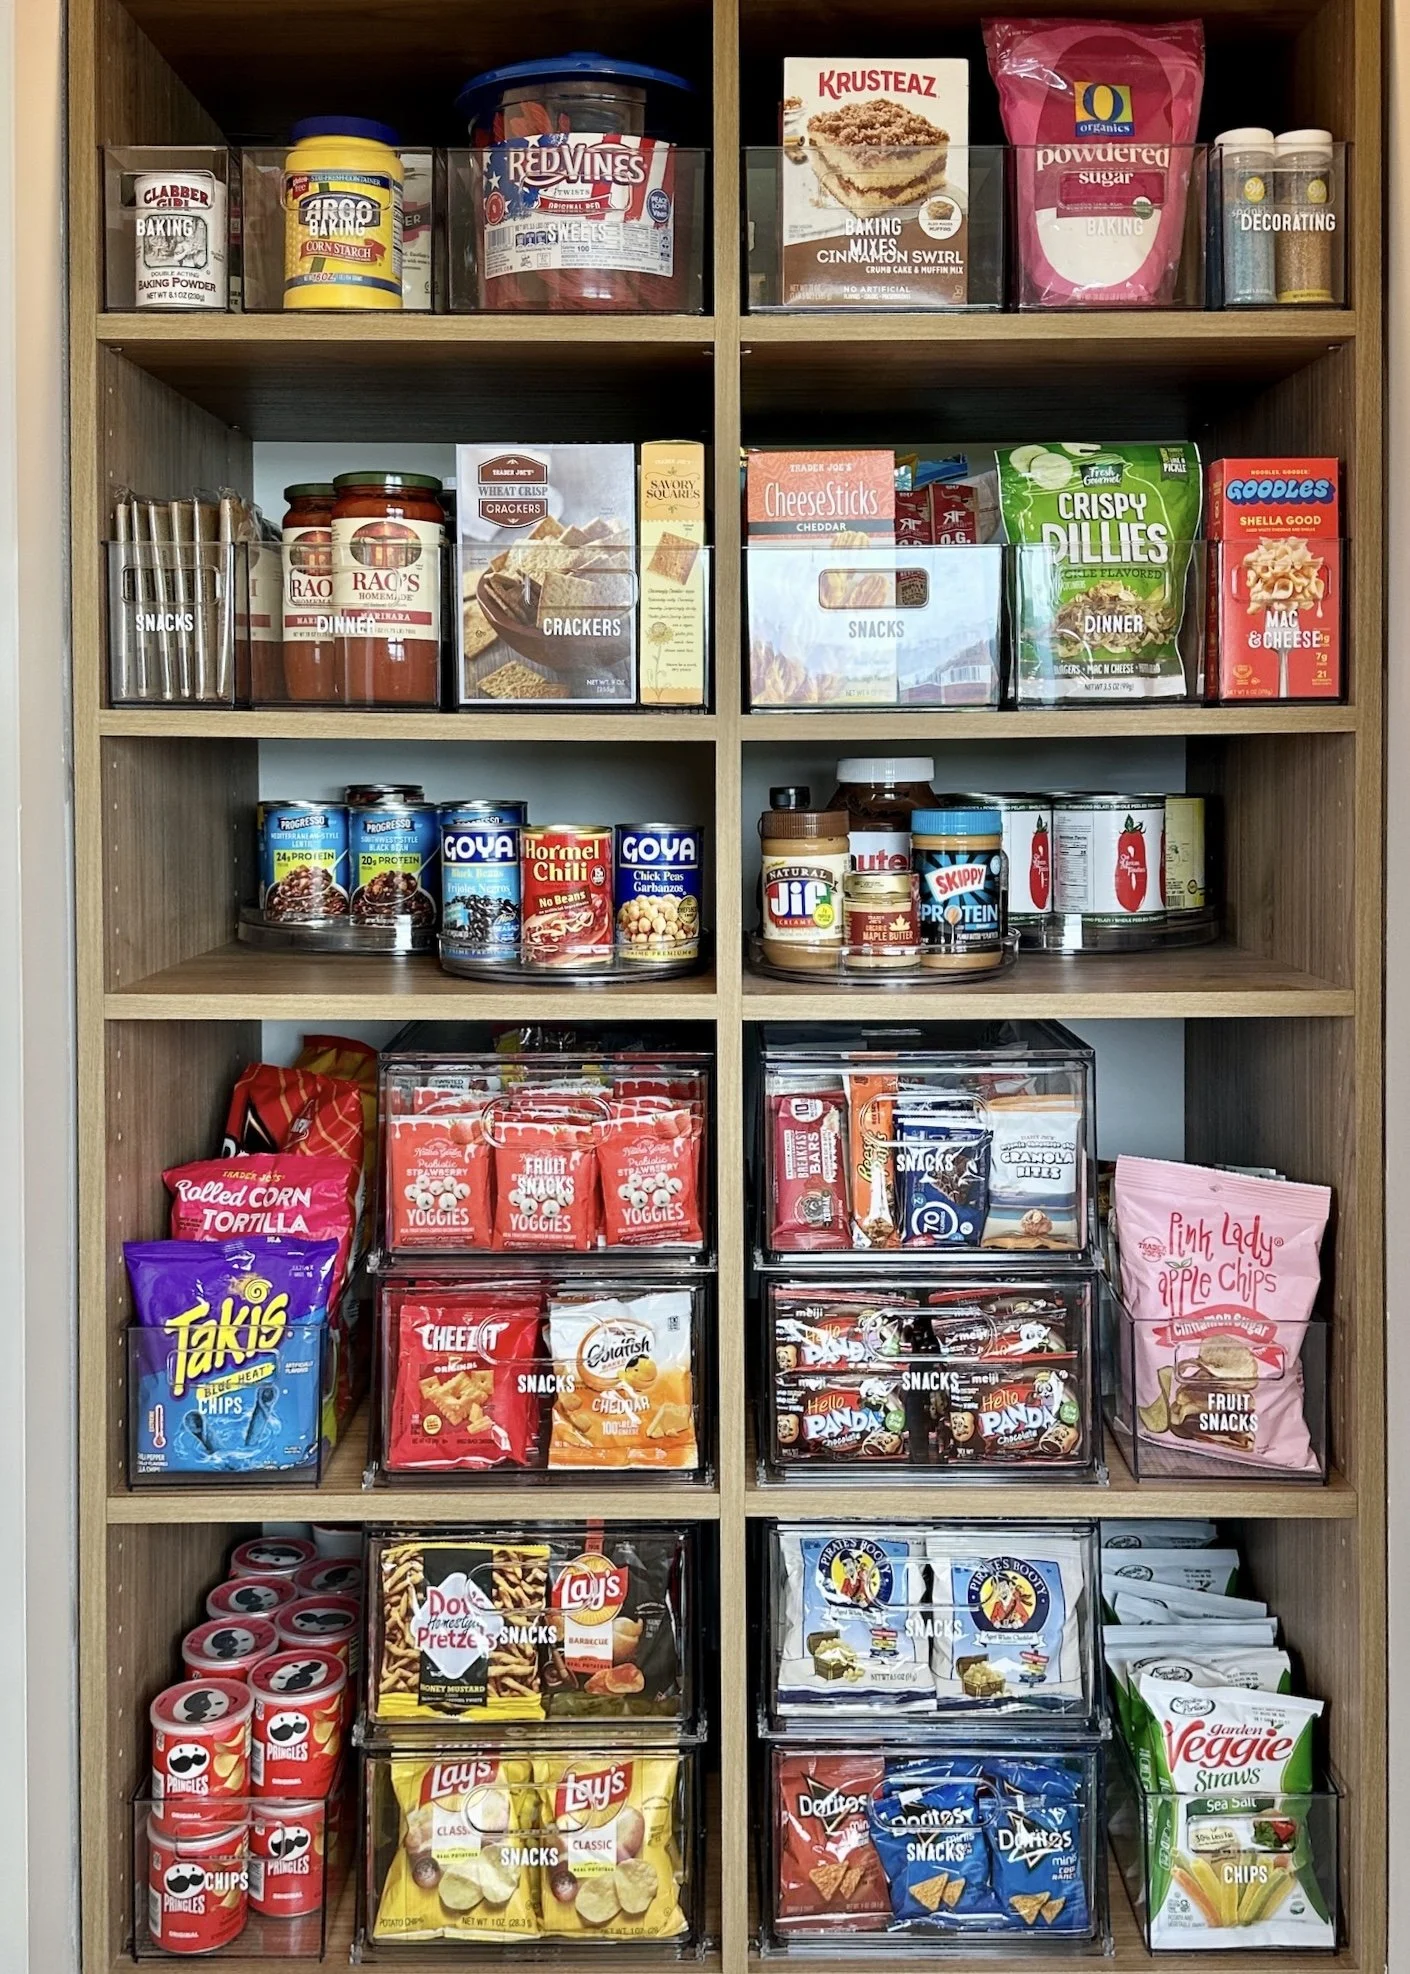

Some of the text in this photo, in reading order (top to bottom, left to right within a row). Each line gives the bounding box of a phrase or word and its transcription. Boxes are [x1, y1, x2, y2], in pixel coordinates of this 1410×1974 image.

[818, 70, 937, 100] KRUSTEAZ
[1080, 122, 1130, 134] organics
[509, 144, 645, 183] RED VINES
[1036, 143, 1170, 171] powdered
[1079, 172, 1134, 186] sugar
[144, 185, 209, 206] CLABBER
[305, 199, 373, 223] ARGO
[136, 219, 193, 237] BAKING
[310, 219, 365, 236] BAKING
[845, 218, 901, 236] BAKING
[1086, 219, 1143, 236] BAKING
[1241, 213, 1336, 231] DECORATING
[548, 223, 606, 240] SWEETS
[307, 241, 371, 257] CORN STARCH
[850, 239, 897, 256] MIXES
[817, 250, 964, 264] CINNAMON SWIRL
[866, 266, 891, 274] CRUMB
[893, 266, 912, 274] CAKE
[921, 266, 948, 274] MUFFIN
[138, 278, 216, 292] BAKING POWDER
[790, 463, 852, 473] TRADER JOE'S
[1088, 466, 1115, 478] Fresh
[1164, 464, 1186, 472] PICKLE
[651, 480, 696, 491] SAVORY
[1084, 474, 1121, 486] Gourmet
[478, 486, 548, 497] WHEAT CRISP
[646, 489, 701, 500] SQUARES
[1227, 479, 1330, 500] GOODLES
[486, 504, 541, 514] CRACKERS
[1058, 492, 1147, 520] CRISPY
[796, 523, 847, 532] CHEDDAR
[1240, 516, 1321, 525] SHELLA GOOD
[1042, 522, 1168, 564] DILLIES
[353, 572, 420, 592] RAO'S
[1101, 569, 1162, 579] FLAVORED
[359, 593, 413, 601] HOMEMADE
[136, 613, 194, 632] SNACKS
[317, 616, 375, 634] DINNER
[360, 612, 411, 621] MARINARA
[1084, 615, 1144, 634] DINNER
[1266, 611, 1298, 628] MAC
[543, 618, 621, 636] CRACKERS
[848, 620, 904, 638] SNACKS
[1316, 652, 1327, 662] 7g
[1111, 664, 1134, 673] CHEESE
[280, 816, 325, 830] PROGRESSO
[366, 819, 411, 834] PROGRESSO
[444, 835, 514, 860] GOYA
[526, 839, 599, 860] Hormel
[623, 837, 696, 862] GOYA
[292, 853, 334, 861] PROTEIN
[378, 856, 419, 865] PROTEIN
[476, 869, 504, 879] Beans
[533, 862, 587, 882] Chili
[633, 871, 684, 881] Chick Peas
[769, 866, 827, 879] NATURAL
[935, 867, 985, 895] SKIPPY
[448, 883, 511, 894] Frijoles Negros
[633, 882, 683, 893] Garbanzos
[539, 891, 586, 908] No Beans
[771, 881, 827, 916] Jif
[922, 904, 998, 922] PROTEIN
[863, 930, 914, 941] MAPLE BUTTER
[794, 1130, 809, 1178] BREAKFAST
[808, 1132, 821, 1174] BARS
[1000, 1151, 1074, 1165] GRANOLA
[526, 1157, 566, 1176] FRUIT
[618, 1163, 678, 1177] STRAWBERRY
[897, 1154, 955, 1172] SNACKS
[406, 1168, 468, 1177] STRAWBERRY
[1016, 1167, 1062, 1179] BITES
[175, 1179, 312, 1208] Rolled CORN
[517, 1178, 574, 1195] SNACKS
[203, 1208, 309, 1234] TORTILLA
[406, 1208, 469, 1226] YOGGIES
[622, 1204, 684, 1224] YOGGIES
[510, 1214, 571, 1233] YOGGIES
[1169, 1212, 1274, 1268] Pink Lady
[1158, 1260, 1277, 1317] apple Chips
[1173, 1314, 1269, 1336] Cinnamon Sugar
[164, 1293, 289, 1397] Takis
[587, 1334, 651, 1367] Goldfish
[434, 1362, 477, 1373] ORIGINAL
[203, 1367, 265, 1398] BLUE HEAT
[517, 1374, 575, 1393] SNACKS
[902, 1371, 960, 1390] SNACKS
[972, 1374, 999, 1385] meiji
[198, 1398, 243, 1414] CHIPS
[808, 1395, 845, 1414] Hello
[982, 1390, 1019, 1411] Hello
[1208, 1393, 1250, 1410] FRUIT
[804, 1408, 883, 1439] PANDA
[979, 1403, 1056, 1437] PANDA
[1199, 1414, 1258, 1431] SNACKS
[860, 1539, 892, 1573] BOOTY
[1013, 1563, 1048, 1596] BOOTY
[561, 1570, 621, 1610] Lay's
[500, 1625, 557, 1644] SNACKS
[905, 1620, 963, 1637] SNACKS
[421, 1684, 485, 1693] HONEY MUSTARD
[1207, 1724, 1262, 1737] garden
[267, 1742, 309, 1762] PRINGLES
[1164, 1720, 1294, 1773] Veggie
[166, 1775, 209, 1795] PRINGLES
[431, 1760, 492, 1797] Lay's
[1195, 1767, 1261, 1792] Straws
[565, 1767, 626, 1812] Lay's
[799, 1792, 870, 1817] Doritos
[1206, 1797, 1258, 1813] Sea Salt
[890, 1807, 965, 1835] Doritos
[573, 1839, 612, 1850] CLASSIC
[999, 1829, 1071, 1850] Doritos
[501, 1848, 559, 1866] SNACKS
[907, 1843, 965, 1862] SNACKS
[268, 1856, 309, 1875] PRINGLES
[1223, 1865, 1268, 1884] CHIPS
[205, 1872, 248, 1891] CHIPS
[164, 1895, 205, 1914] PRINGLES
